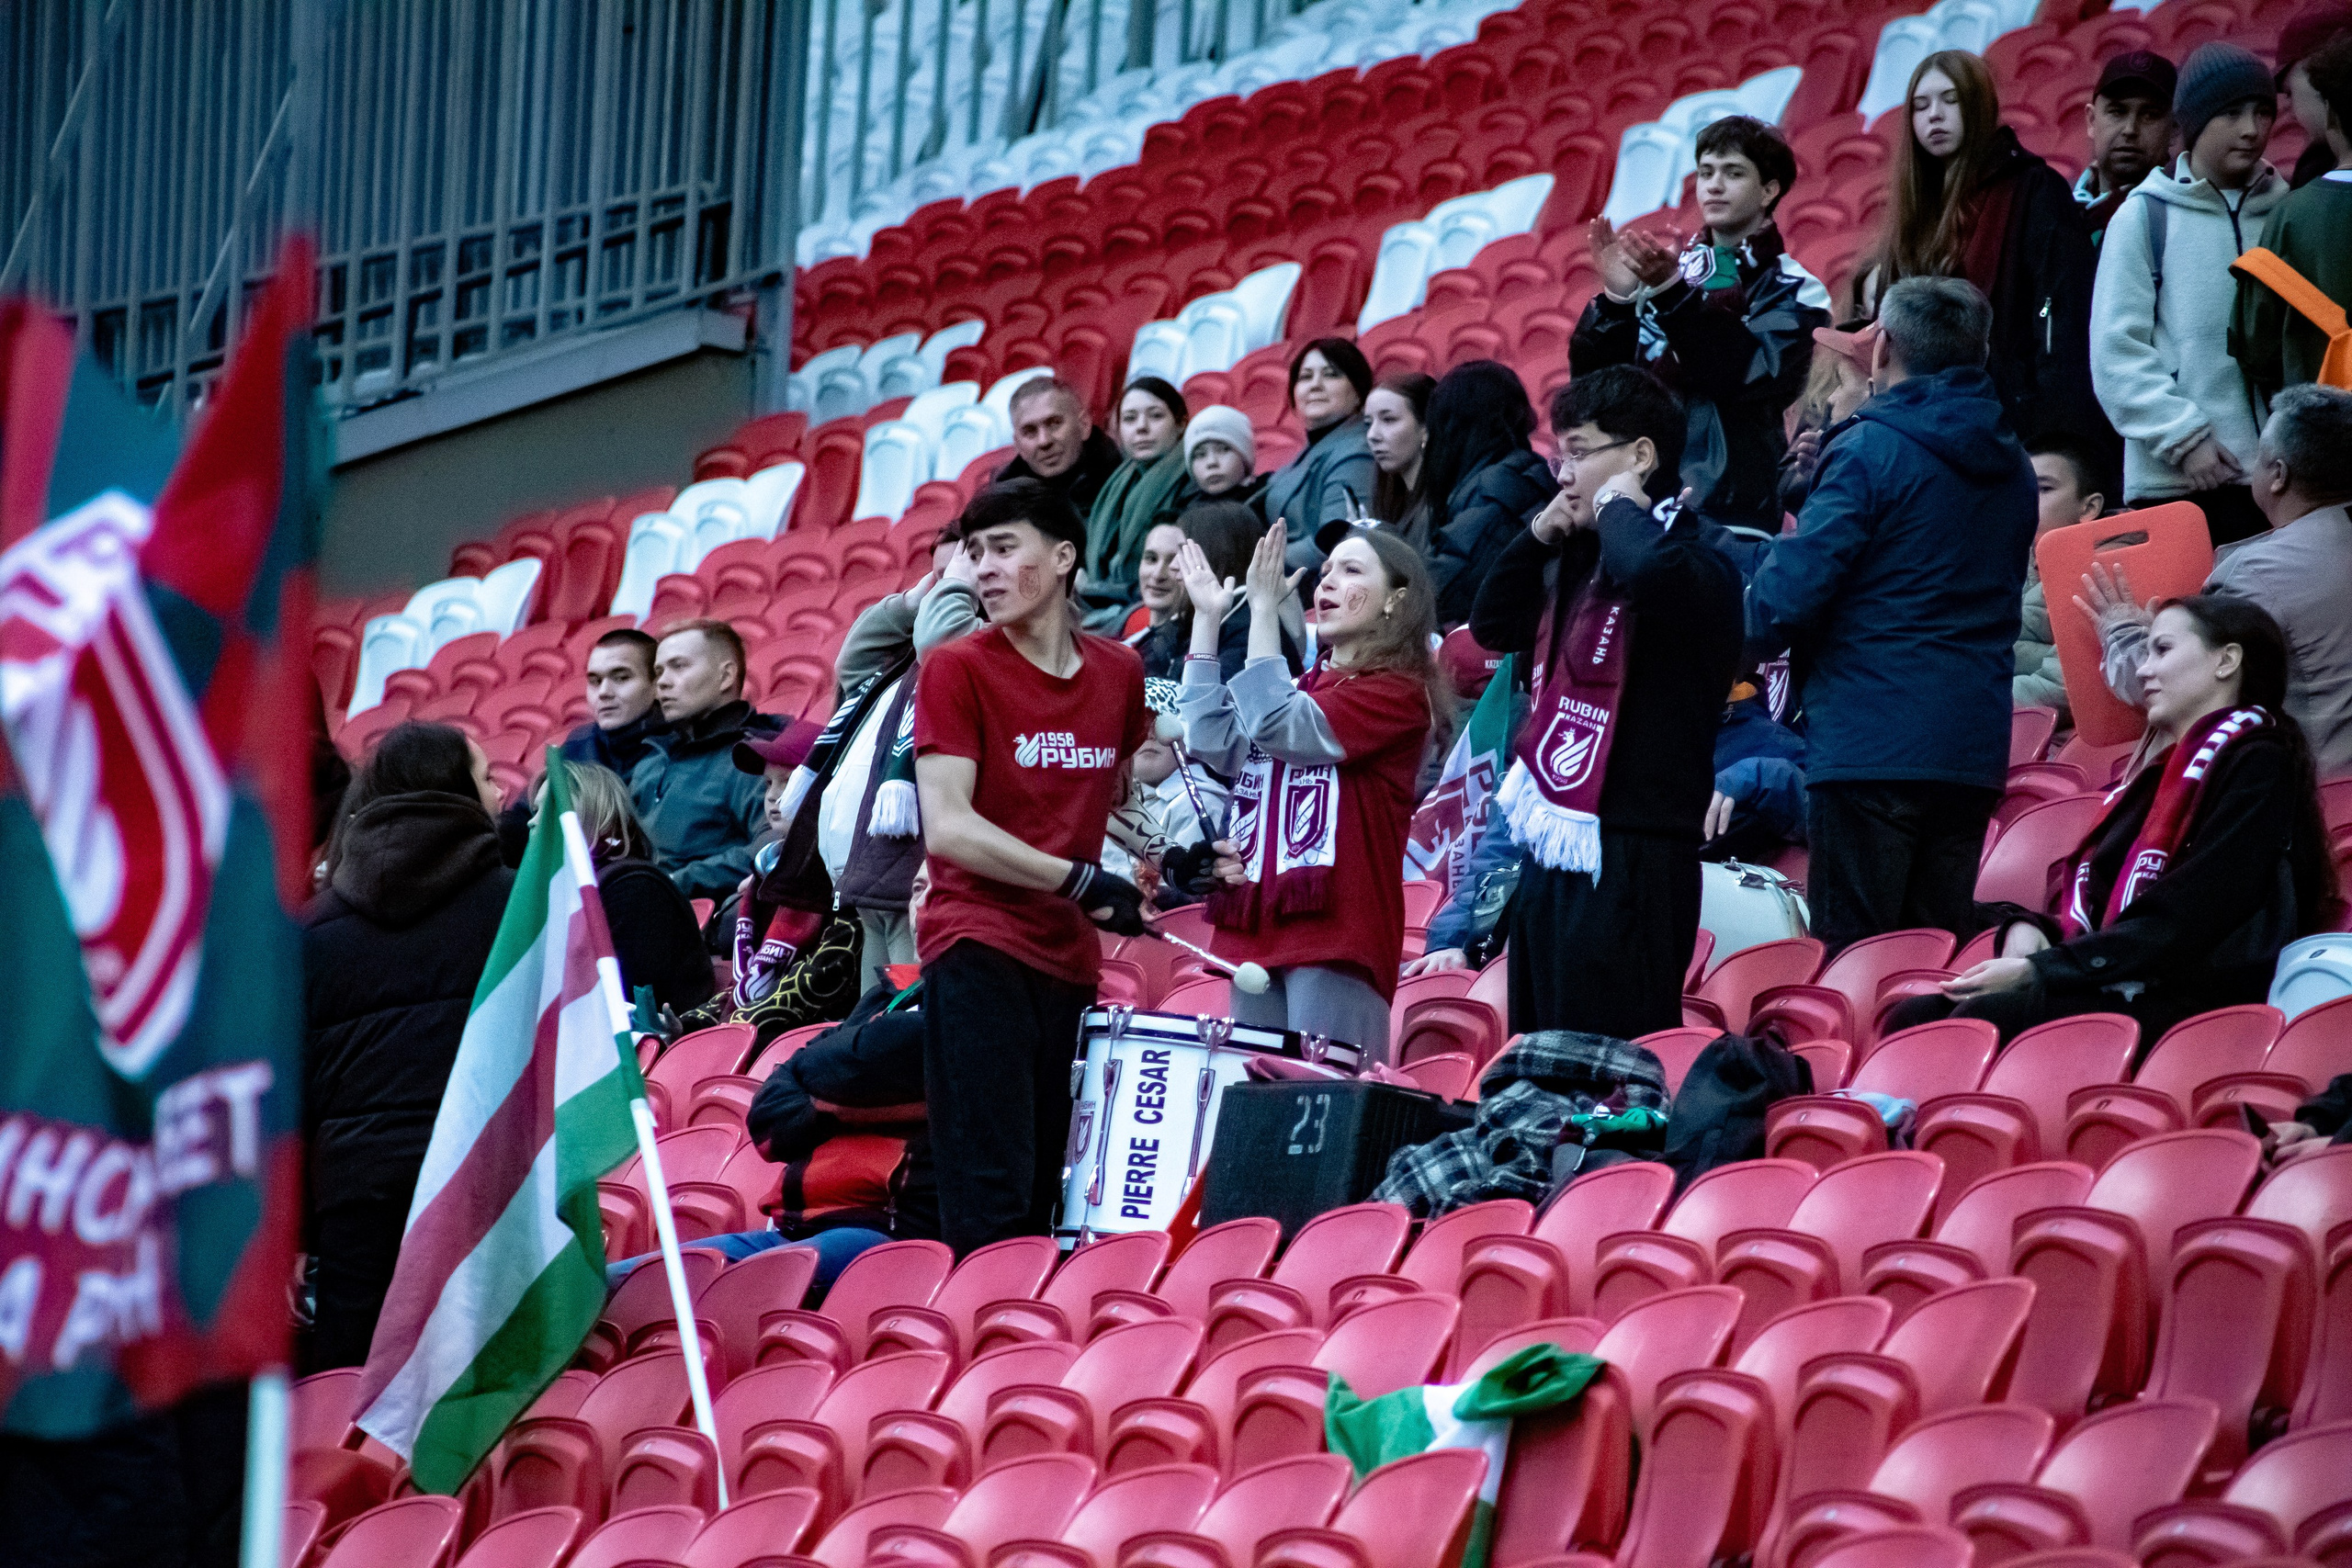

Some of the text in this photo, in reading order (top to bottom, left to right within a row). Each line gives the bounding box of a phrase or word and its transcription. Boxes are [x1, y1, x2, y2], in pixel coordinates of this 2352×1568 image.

[1592, 605, 1621, 665] КАЗАНЬ
[1558, 695, 1610, 725] RUBIN
[1565, 713, 1598, 731] KAZAN
[1040, 732, 1075, 748] 1958
[1041, 748, 1116, 769] РУБИН
[1120, 1049, 1171, 1220] PIERRE CESAR
[1288, 1094, 1331, 1155] 23
